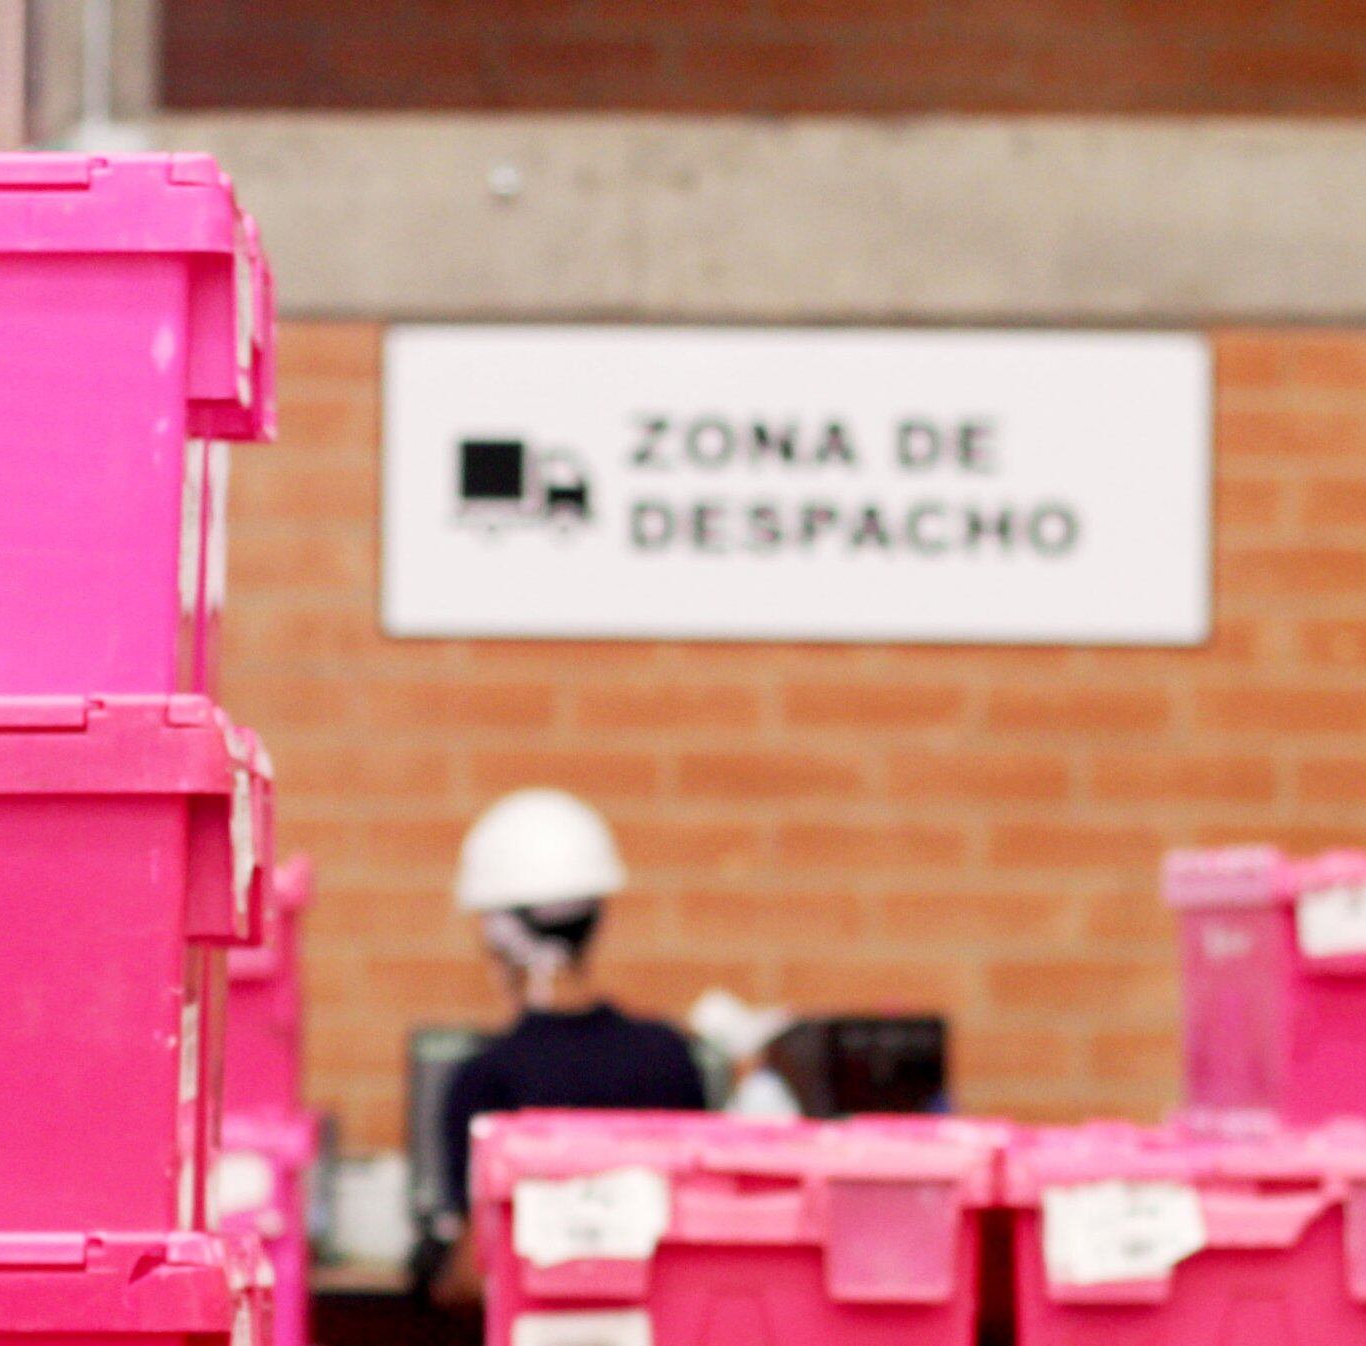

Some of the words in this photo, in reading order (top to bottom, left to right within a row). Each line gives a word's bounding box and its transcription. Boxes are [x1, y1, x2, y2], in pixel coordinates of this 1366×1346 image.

[628, 418, 856, 469] ZONA
[896, 419, 996, 470] DE
[630, 504, 1081, 556] DESPACHO
